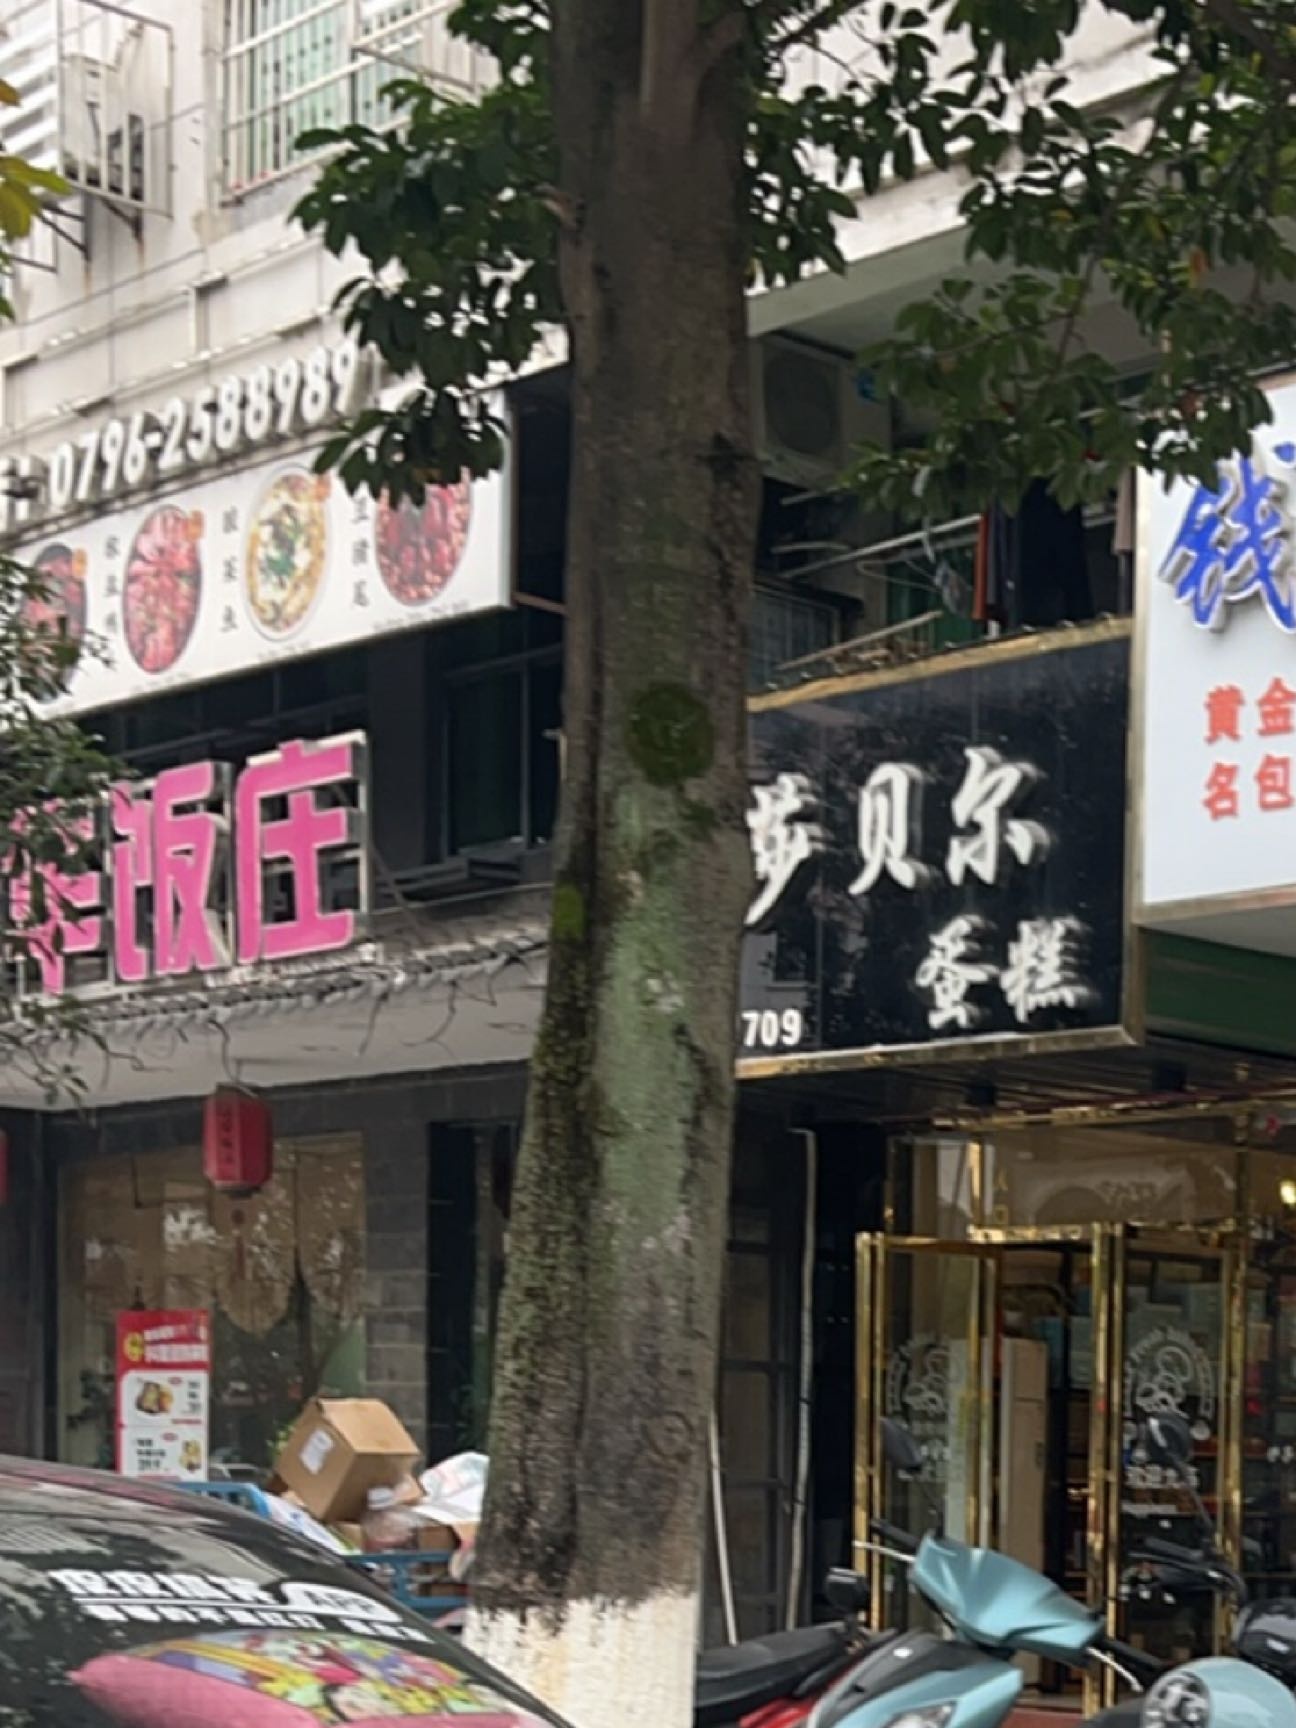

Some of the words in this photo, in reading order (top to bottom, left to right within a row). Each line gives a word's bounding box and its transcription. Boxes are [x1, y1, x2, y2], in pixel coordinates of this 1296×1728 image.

[1202, 753, 1296, 820] 名包
[915, 914, 1094, 1029] 蛋糕
[741, 1008, 801, 1046] 709
